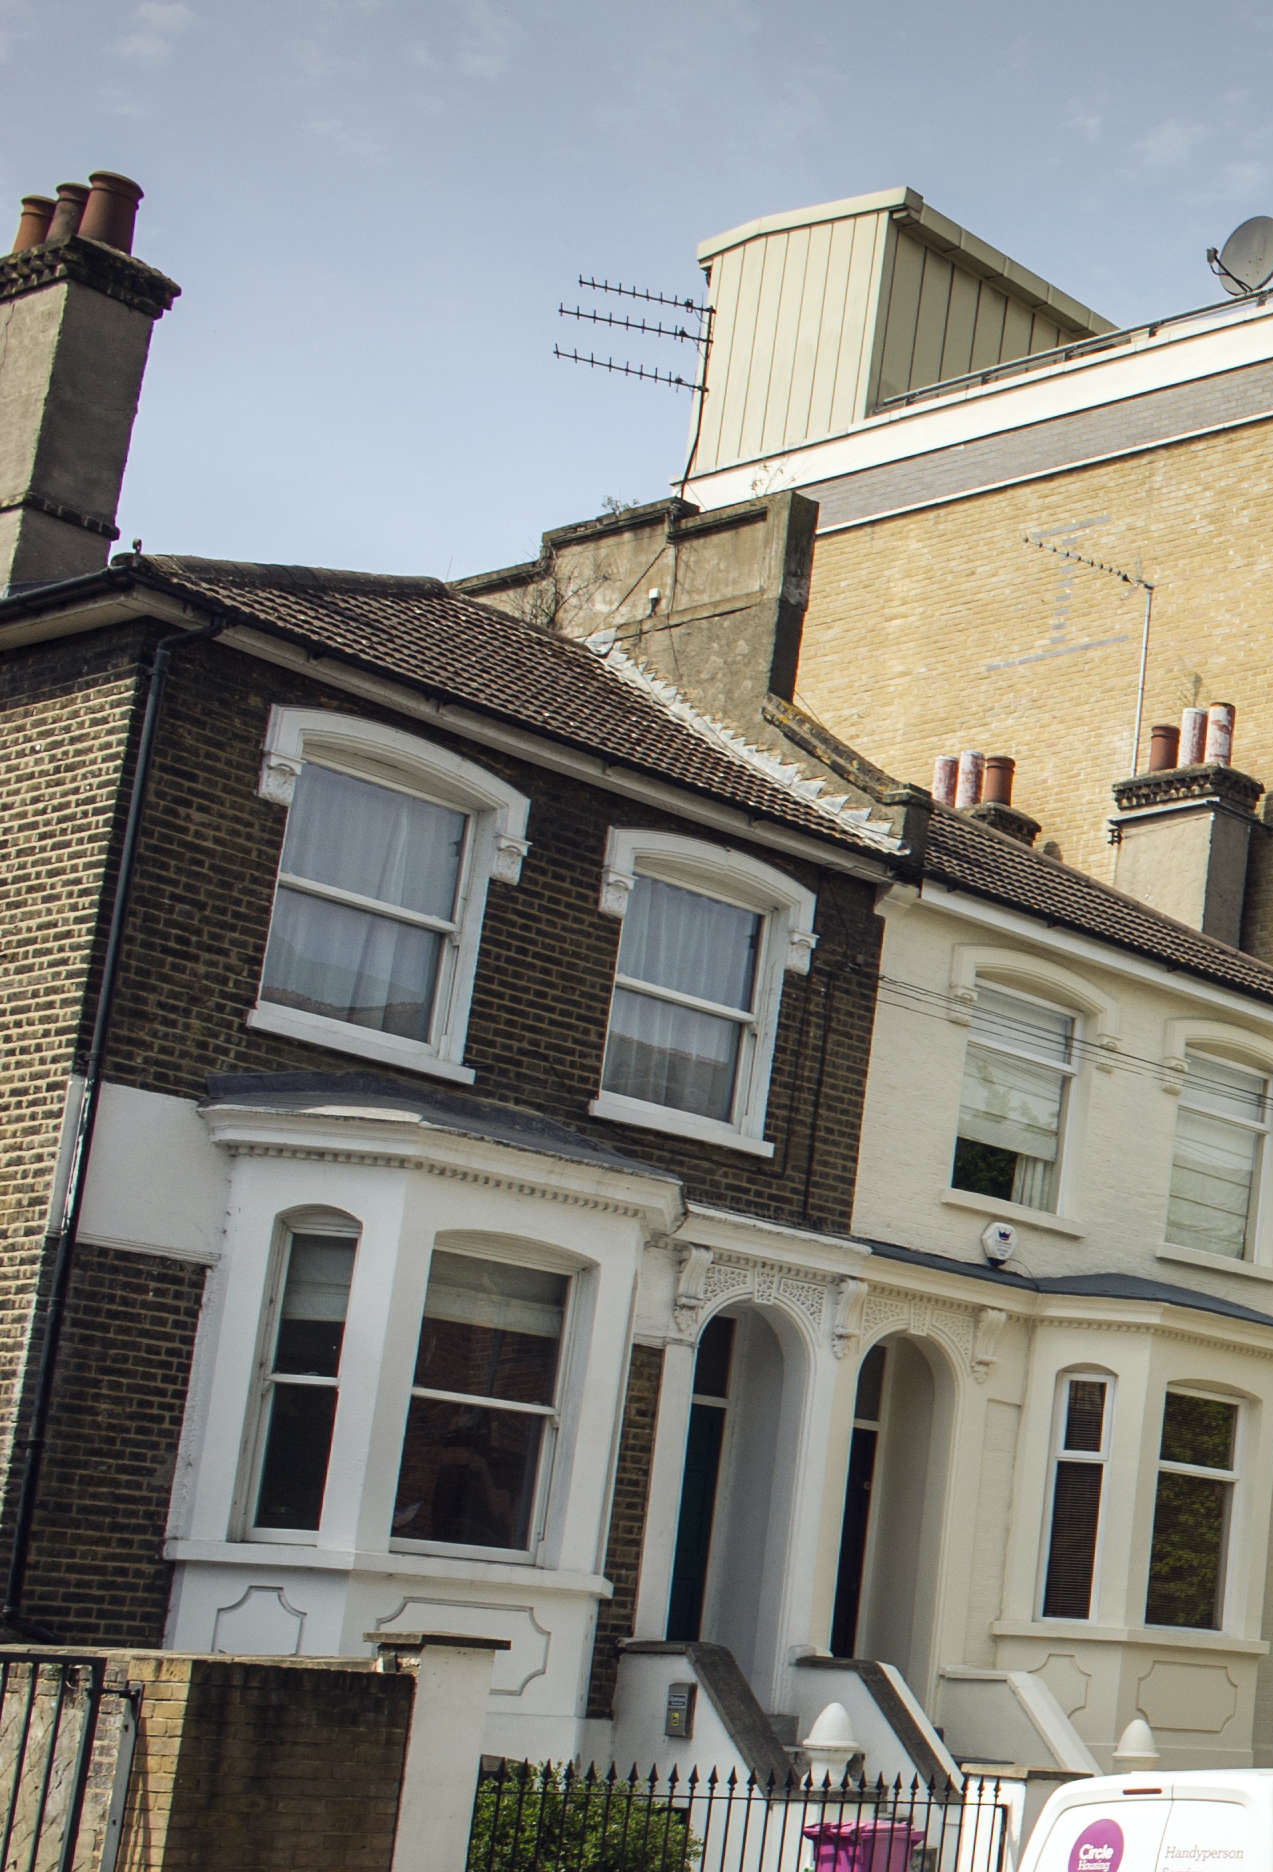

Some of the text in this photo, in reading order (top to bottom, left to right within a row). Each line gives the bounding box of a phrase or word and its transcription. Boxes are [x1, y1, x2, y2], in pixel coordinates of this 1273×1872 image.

[1078, 1844, 1115, 1860] Circle
[1165, 1844, 1244, 1861] Handyperson
[1077, 1860, 1111, 1872] Housing
